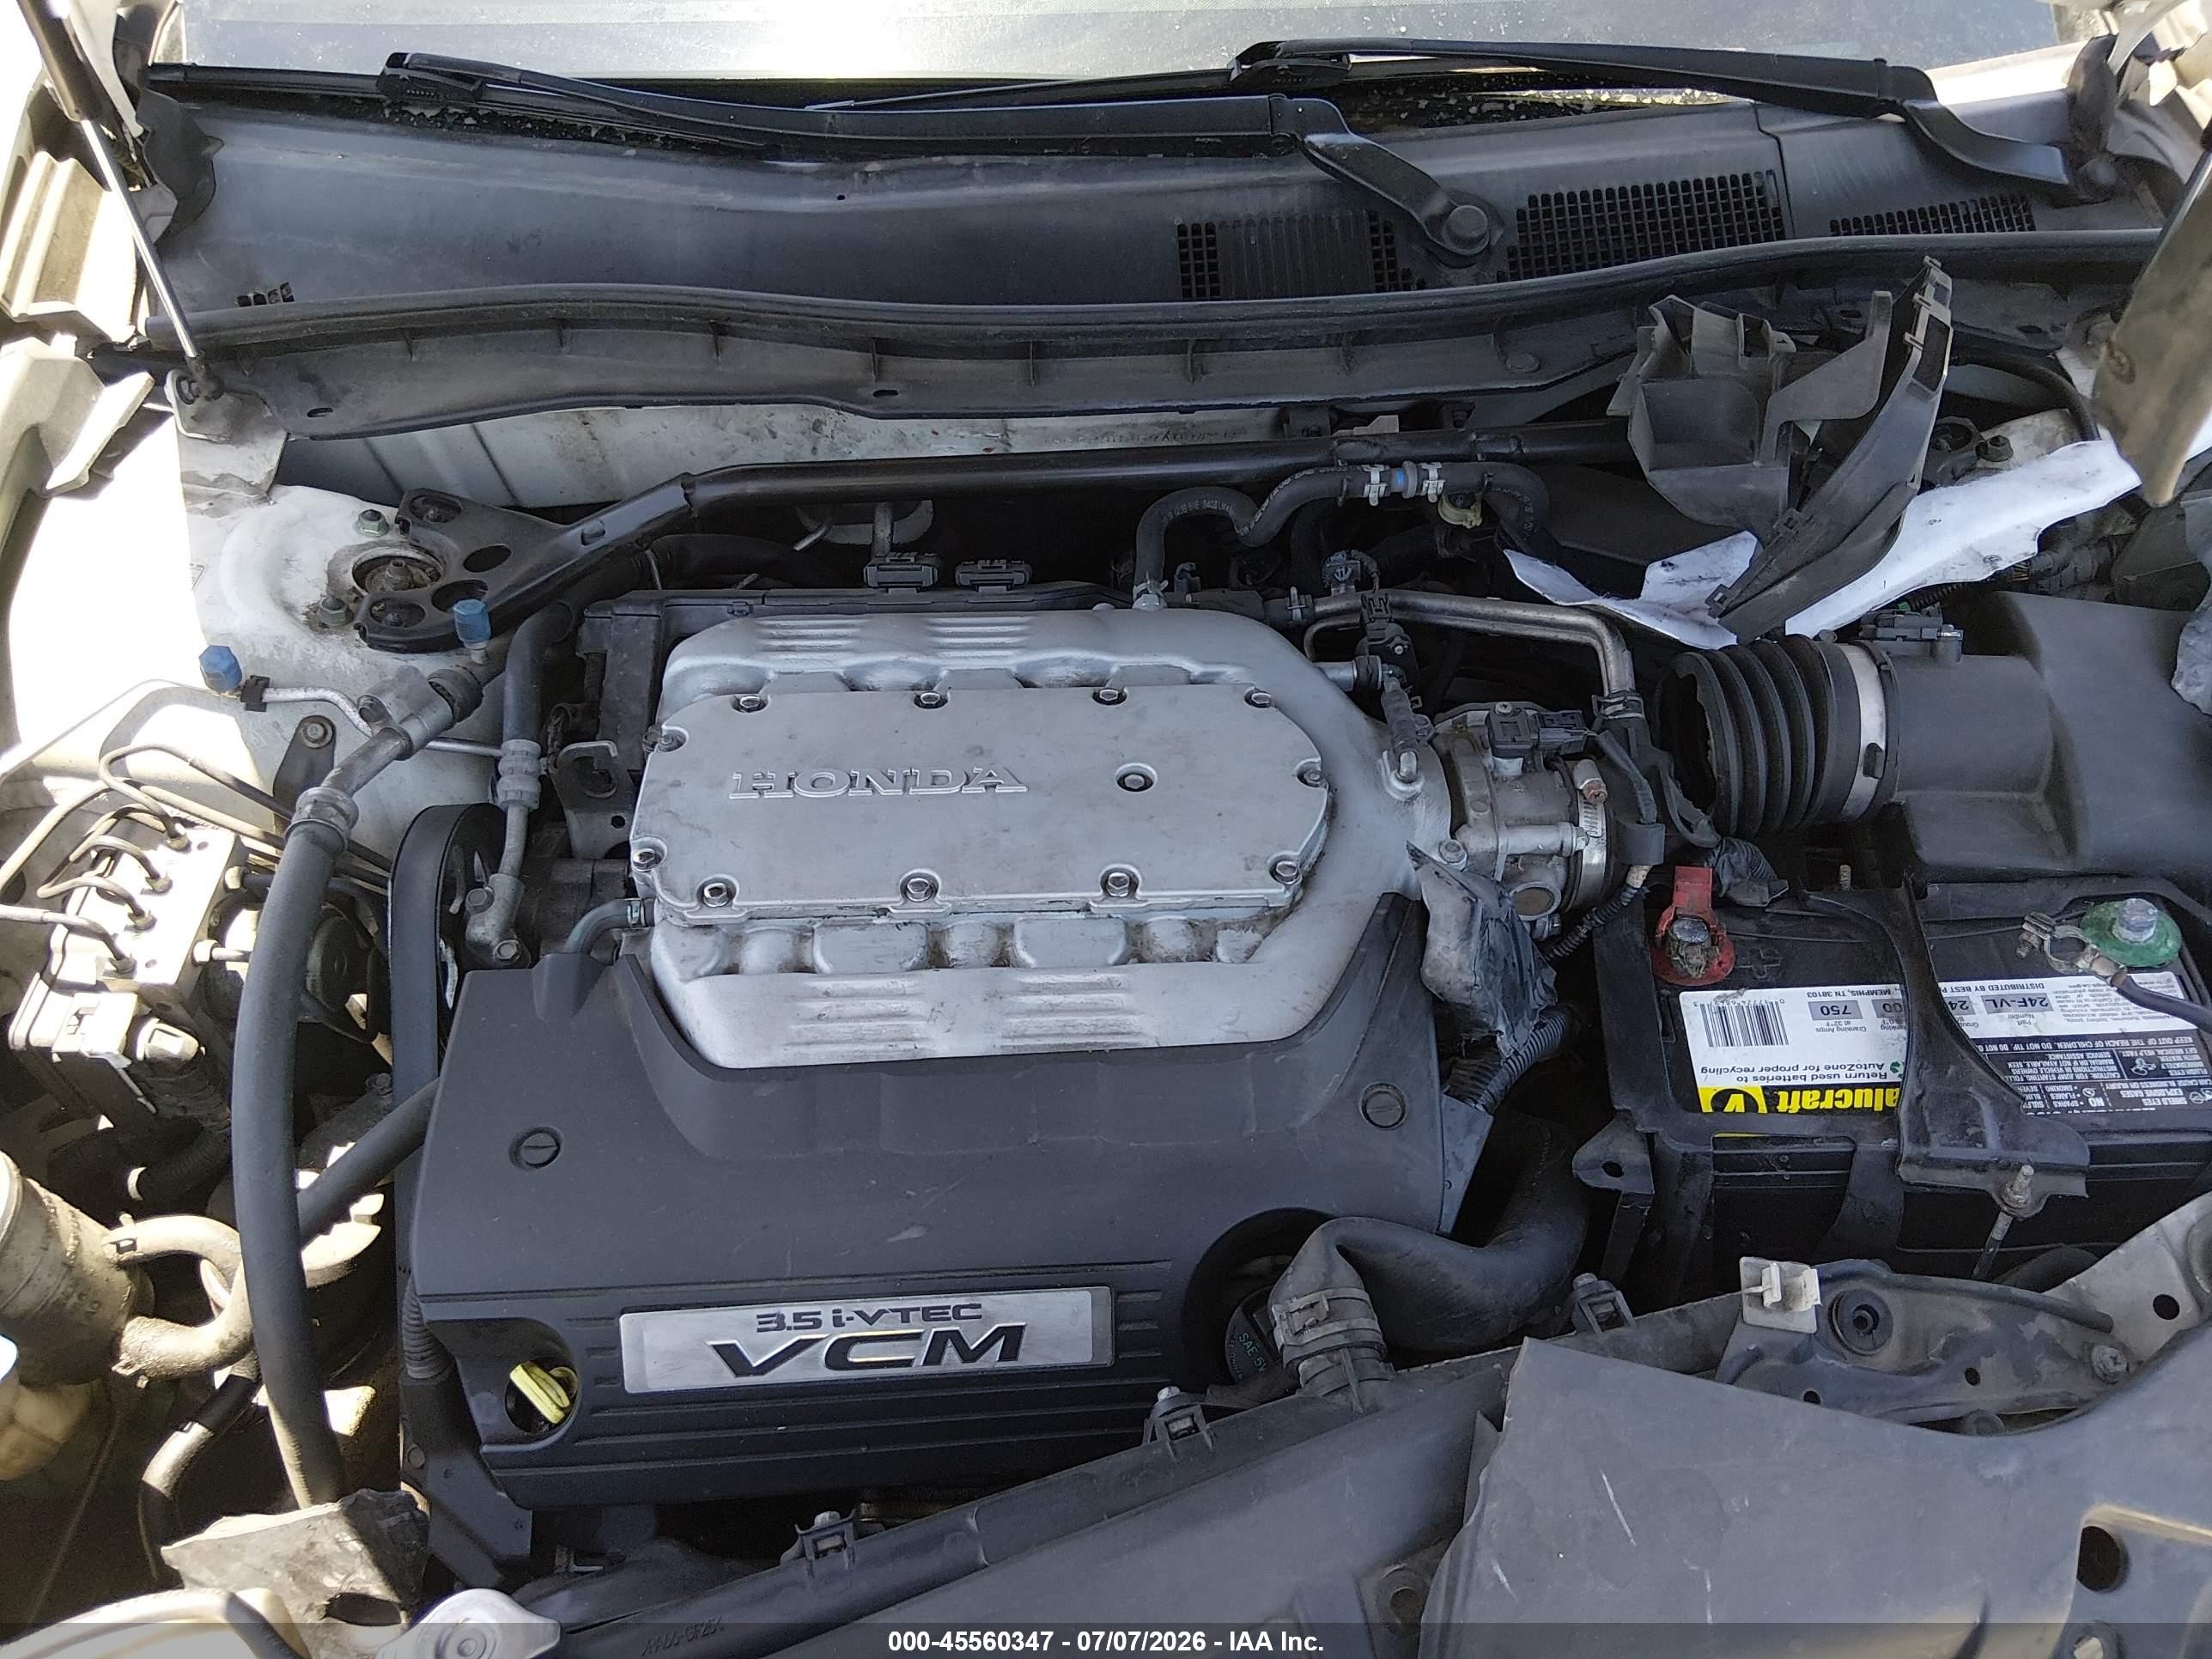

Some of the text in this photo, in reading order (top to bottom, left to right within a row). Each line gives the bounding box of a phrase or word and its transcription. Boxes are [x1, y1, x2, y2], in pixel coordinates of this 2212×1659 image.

[729, 767, 1028, 798] HONDA
[1988, 983, 2045, 992] DISTRIBUTED
[1985, 997, 2049, 1009] 24F-VL
[1820, 1005, 1851, 1016] 750
[1701, 1066, 1756, 1076] recycling
[1825, 1063, 1885, 1073] AutoZone
[1844, 1072, 1887, 1080] Return
[1776, 1088, 1900, 1114] alucraft
[2087, 1097, 2105, 1108] NO
[757, 1304, 982, 1333] 3.5 i-VTEC
[706, 1322, 1027, 1378] VCM
[1238, 1333, 1258, 1357] SAE
